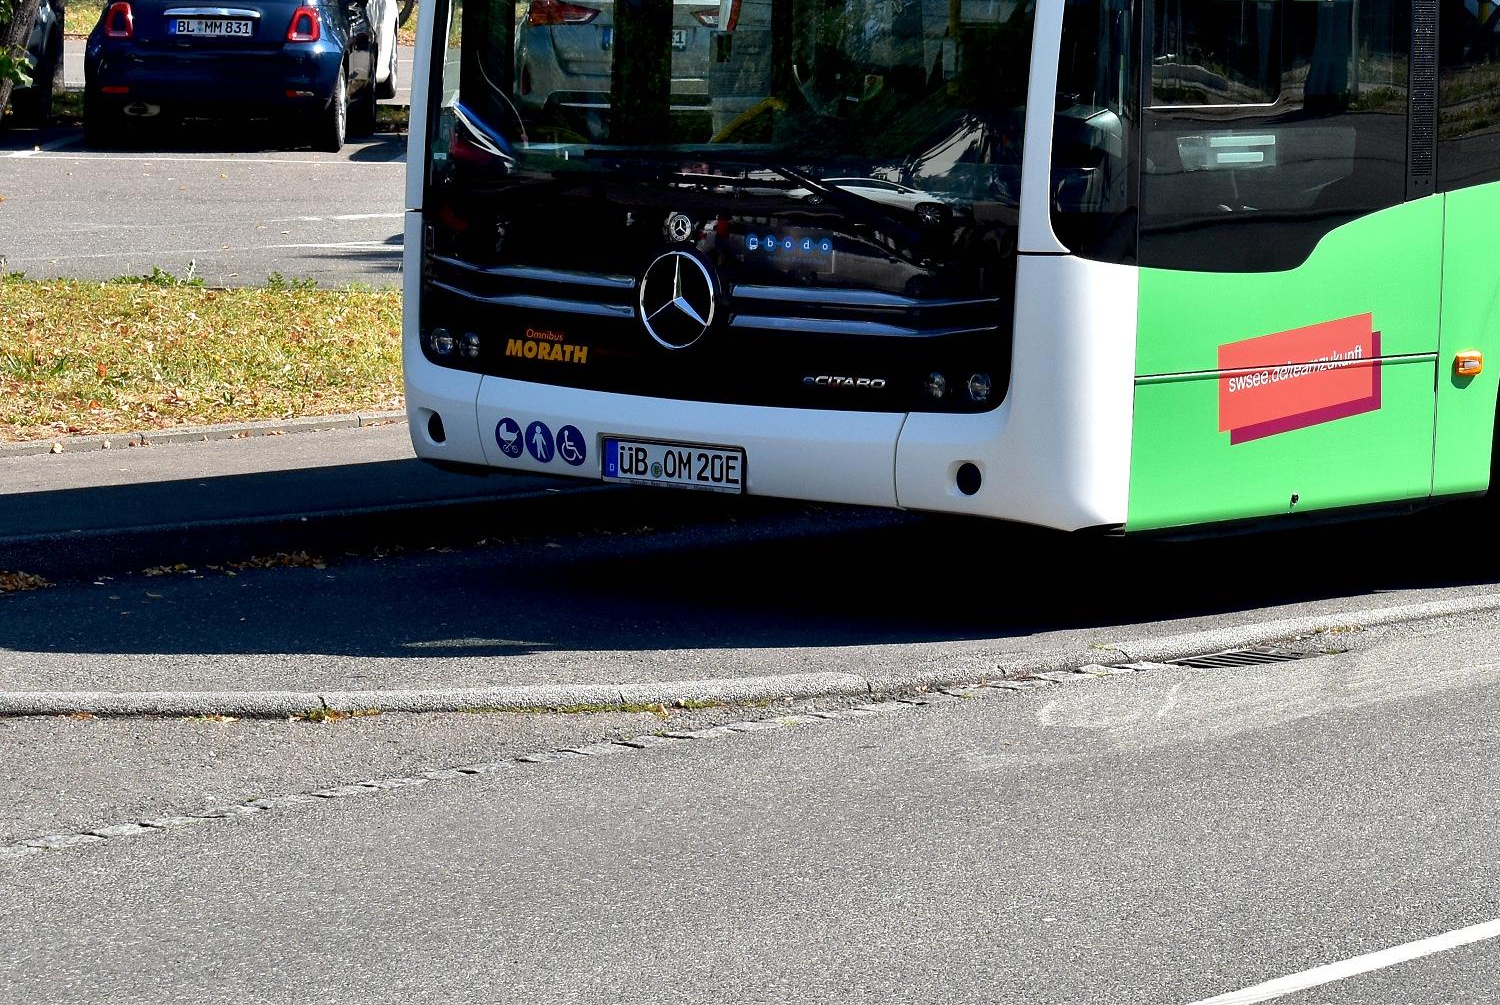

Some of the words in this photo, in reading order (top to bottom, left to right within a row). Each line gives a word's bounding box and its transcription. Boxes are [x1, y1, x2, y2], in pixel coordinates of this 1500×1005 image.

[177, 21, 195, 33] BL
[204, 22, 222, 33] MM
[225, 22, 250, 34] 831
[767, 237, 829, 250] bodo
[526, 328, 564, 341] Omnibus
[505, 338, 589, 364] MORATH
[803, 375, 886, 389] eCITARO
[619, 445, 648, 476] ÜB
[663, 449, 692, 480] OM
[696, 453, 740, 485] 20E
